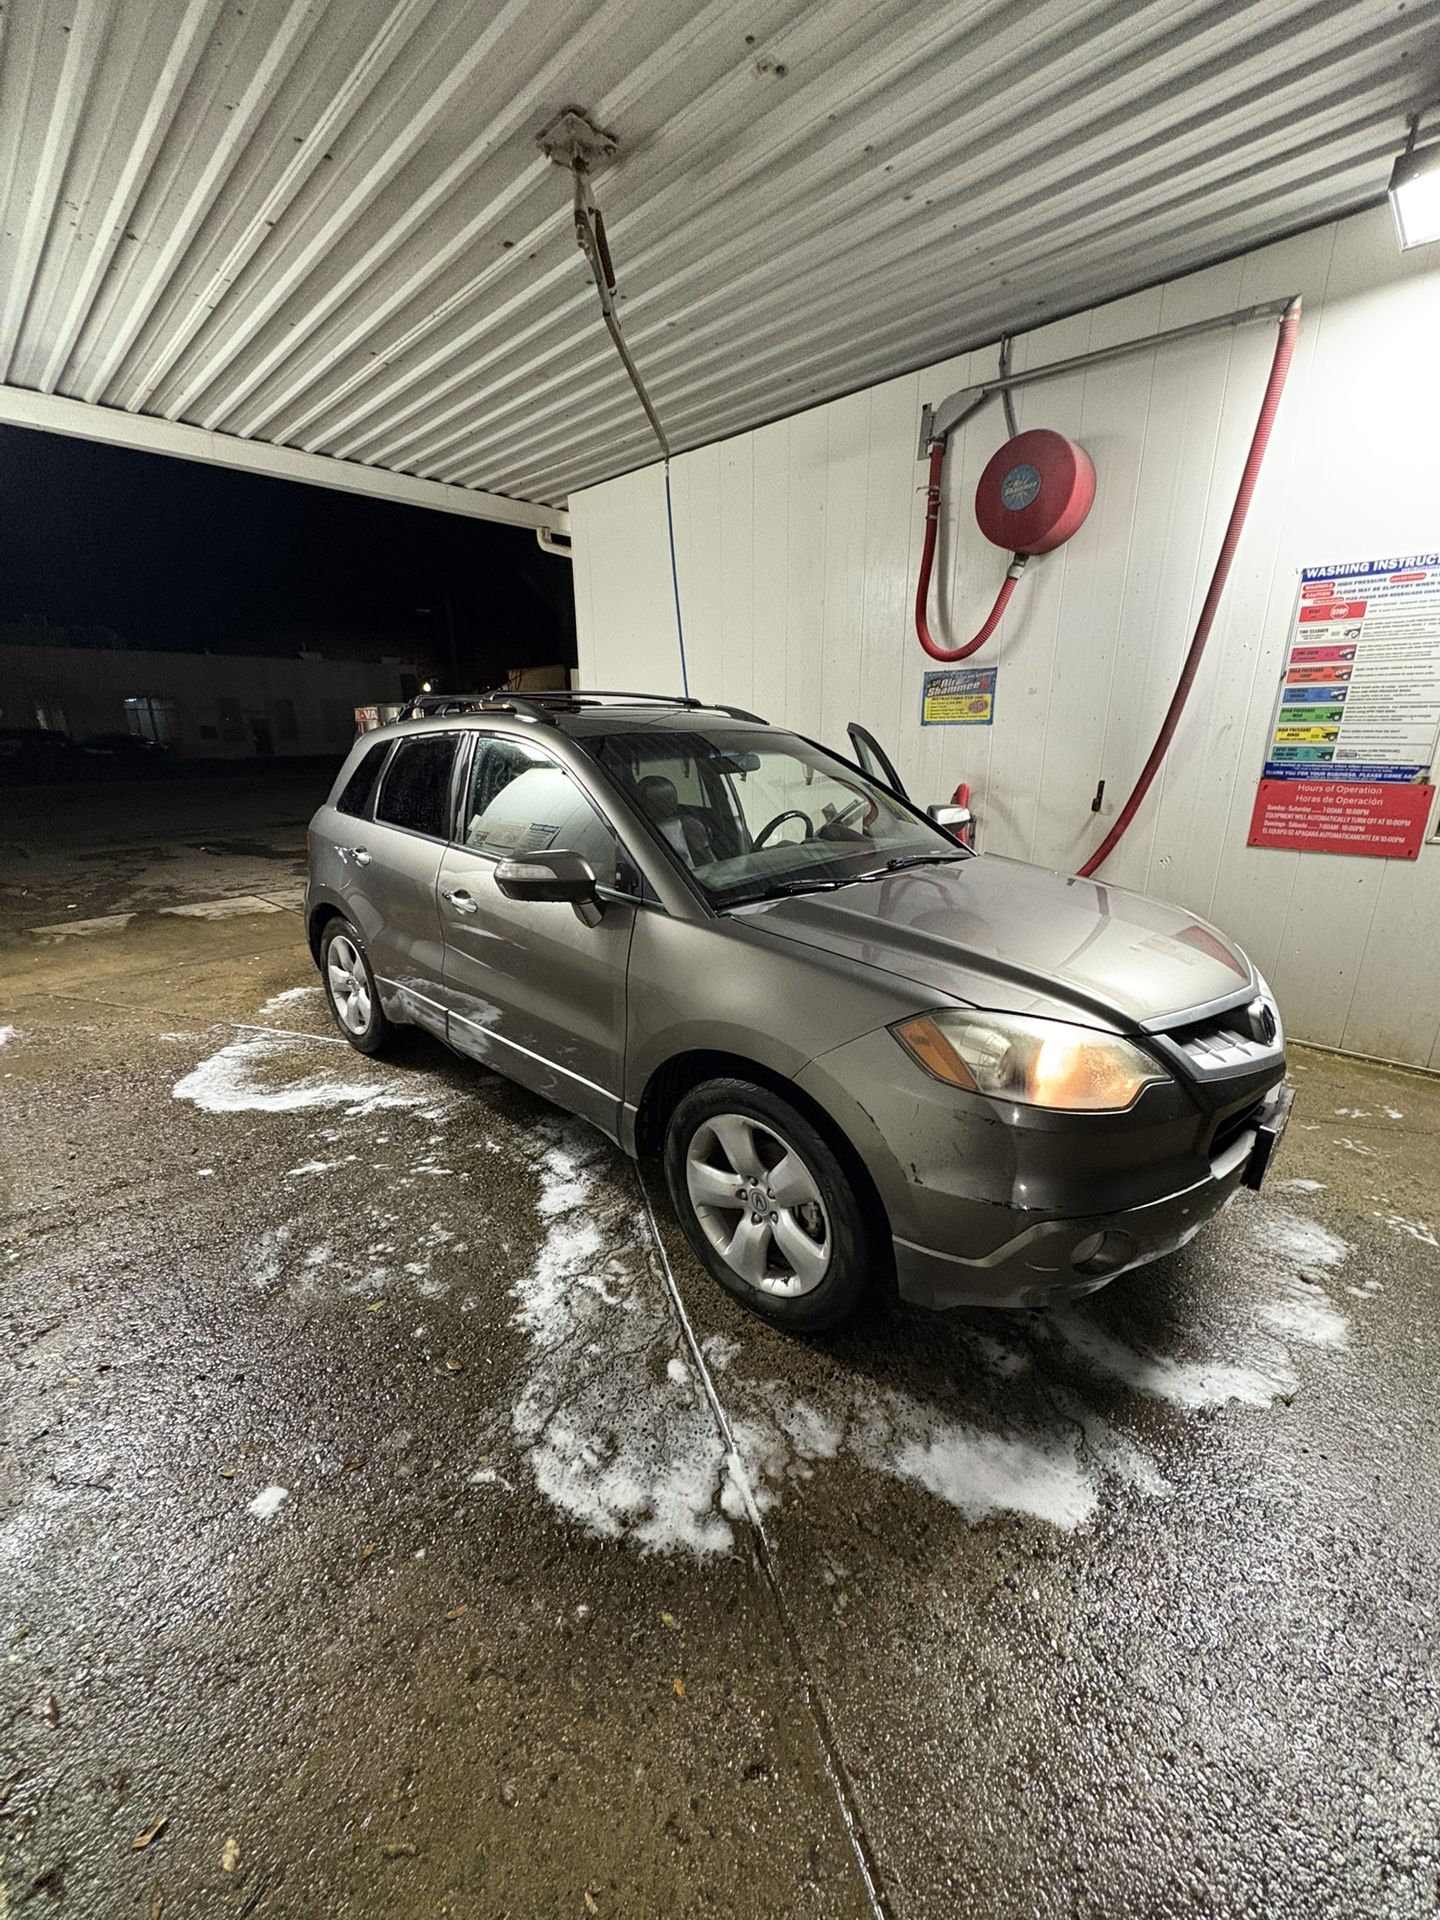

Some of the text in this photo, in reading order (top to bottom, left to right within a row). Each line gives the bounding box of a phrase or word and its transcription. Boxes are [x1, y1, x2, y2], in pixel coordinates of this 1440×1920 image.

[1307, 562, 1370, 578] WASHING
[1354, 577, 1387, 585] PRESSURE
[1331, 607, 1348, 616] STOP
[927, 681, 980, 697] Shammee
[1297, 784, 1324, 792] Hours
[1336, 785, 1382, 794] Operation
[1295, 794, 1383, 805] Horas de Operación
[1288, 805, 1311, 813] Saturday
[1307, 814, 1350, 823] AUTOMATICALLY
[1371, 834, 1380, 842] EN
